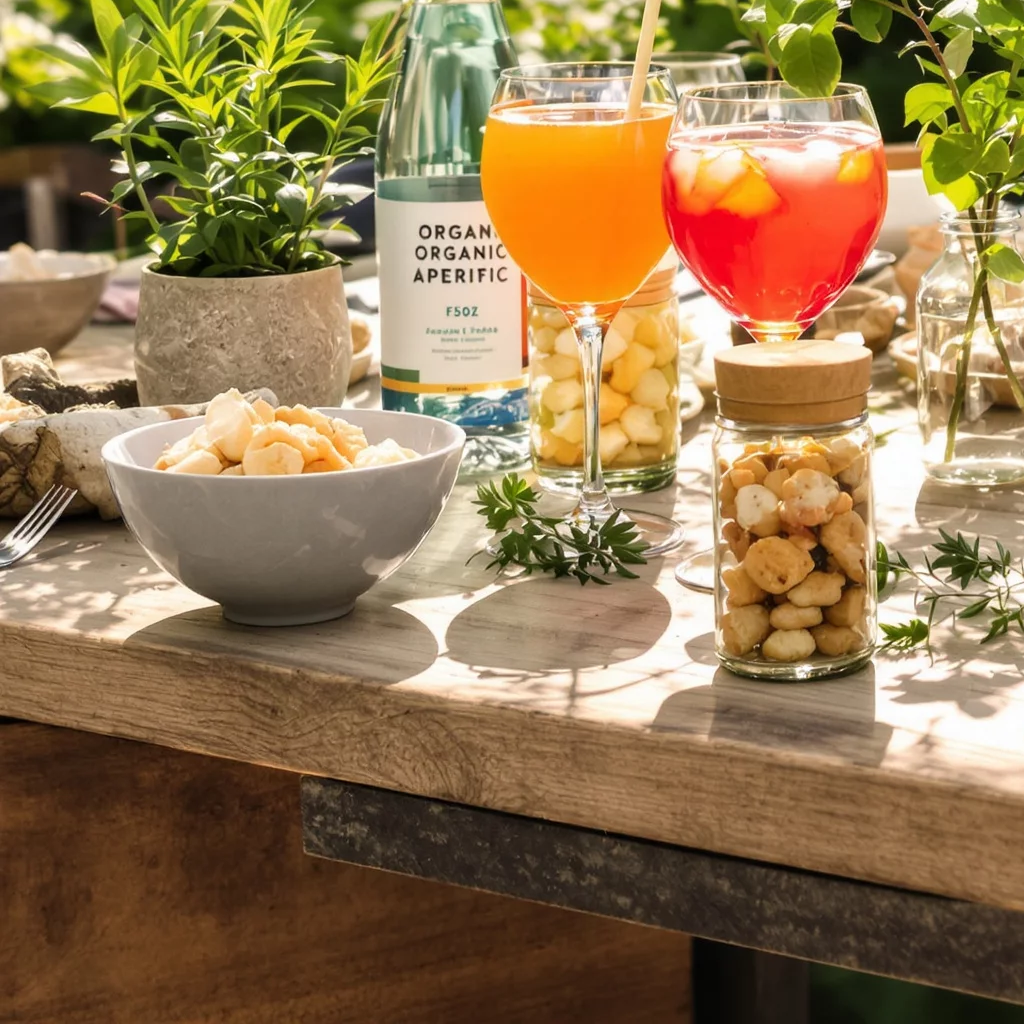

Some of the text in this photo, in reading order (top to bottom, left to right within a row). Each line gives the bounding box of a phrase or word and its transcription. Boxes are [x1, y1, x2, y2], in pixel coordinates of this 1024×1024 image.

[418, 224, 498, 240] ORGAN
[415, 243, 507, 261] ORGANIC
[413, 267, 508, 284] APERIFIC
